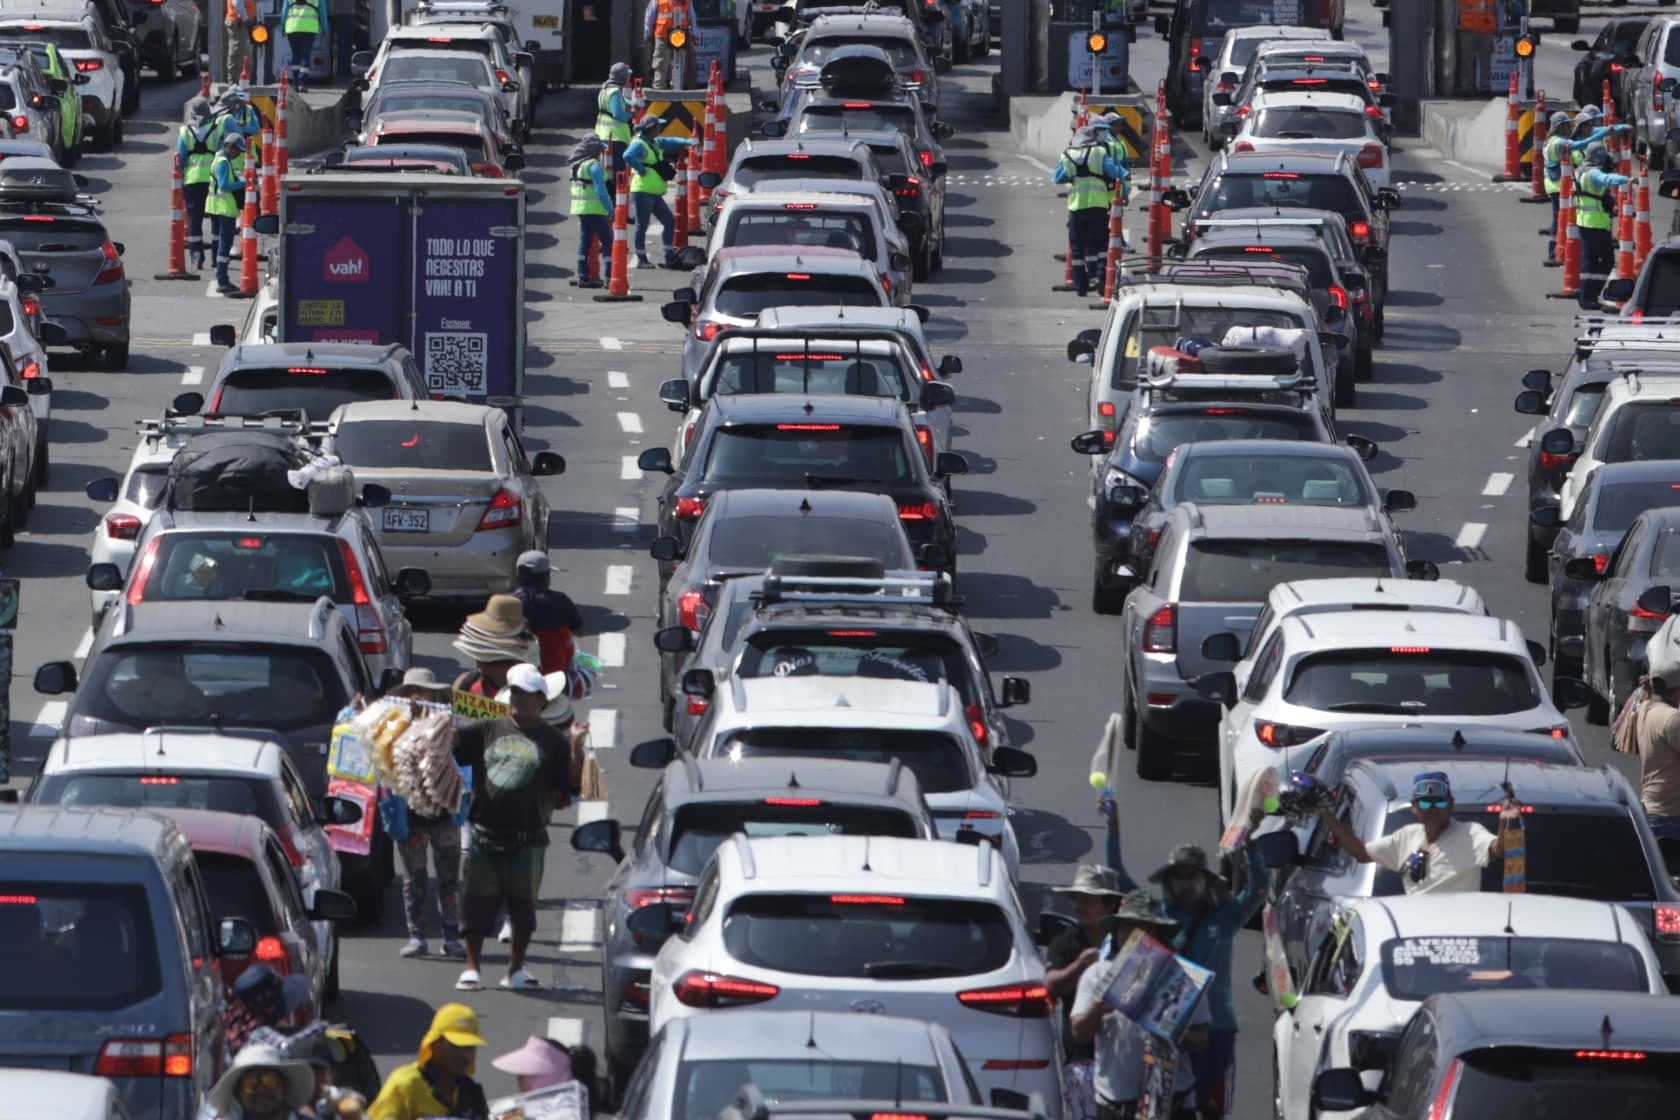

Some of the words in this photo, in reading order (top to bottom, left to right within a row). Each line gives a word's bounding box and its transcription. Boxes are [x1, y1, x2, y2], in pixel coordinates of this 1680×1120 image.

[426, 238, 454, 257] TODO
[456, 239, 470, 257] LO
[473, 240, 495, 257] QUE
[329, 258, 363, 275] vah!
[425, 258, 484, 277] NECESITAS
[465, 280, 477, 298] TI
[441, 317, 473, 330] Escanea:
